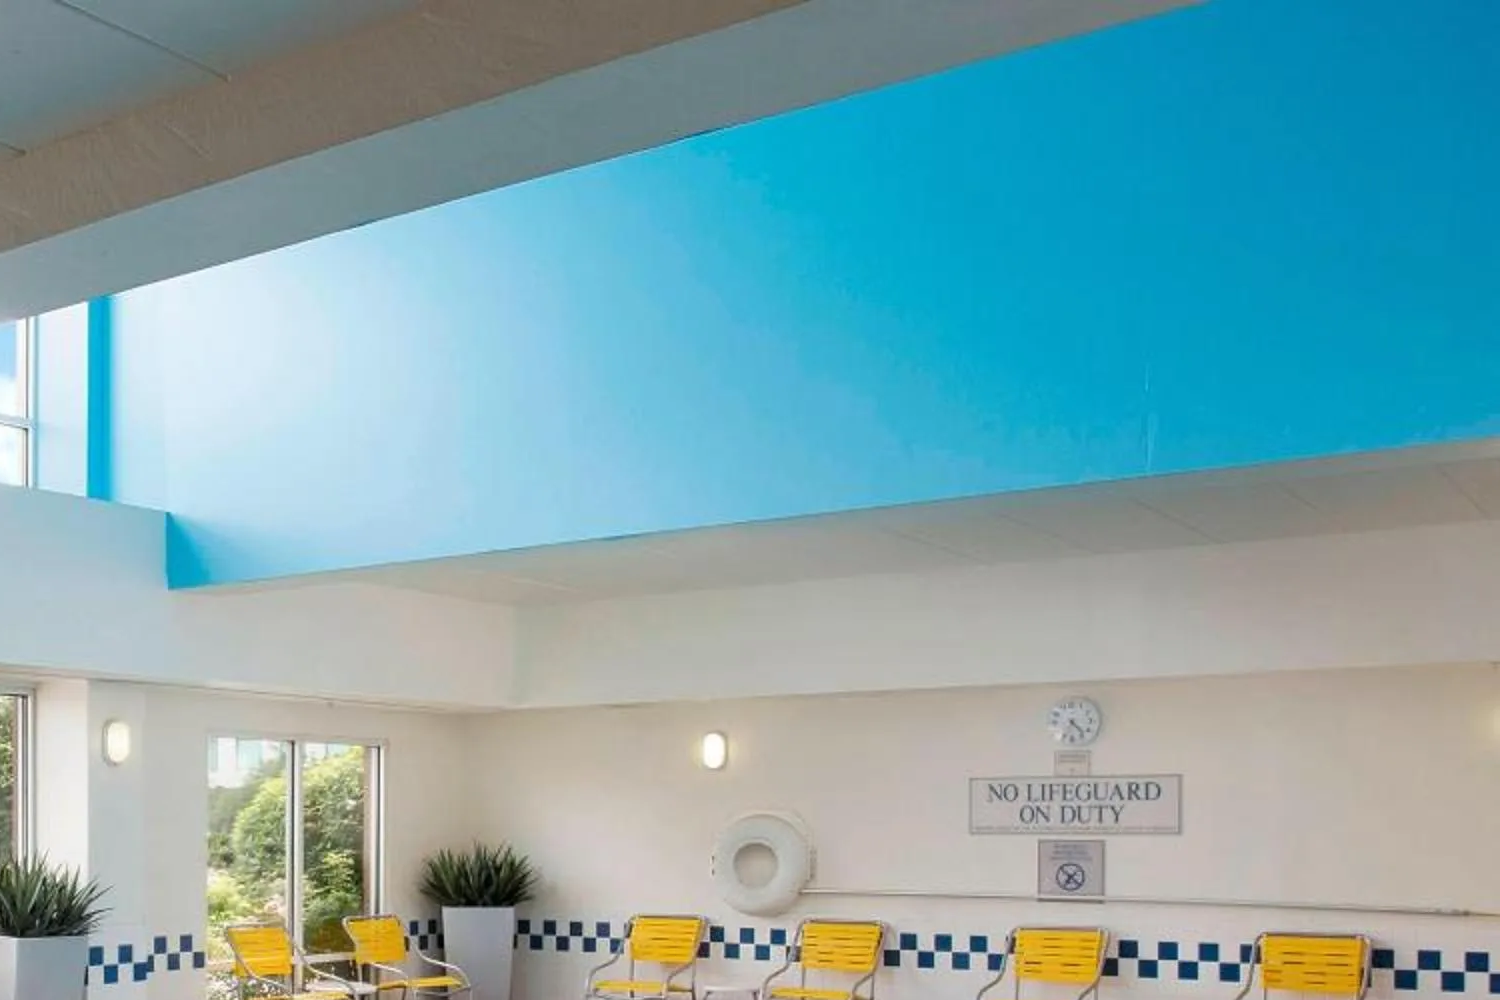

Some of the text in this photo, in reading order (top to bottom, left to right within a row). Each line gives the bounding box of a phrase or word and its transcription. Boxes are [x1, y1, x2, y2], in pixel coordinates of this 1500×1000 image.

[987, 781, 1161, 802] NO LIFEGUARD
[1019, 805, 1125, 824] ON DUTY
